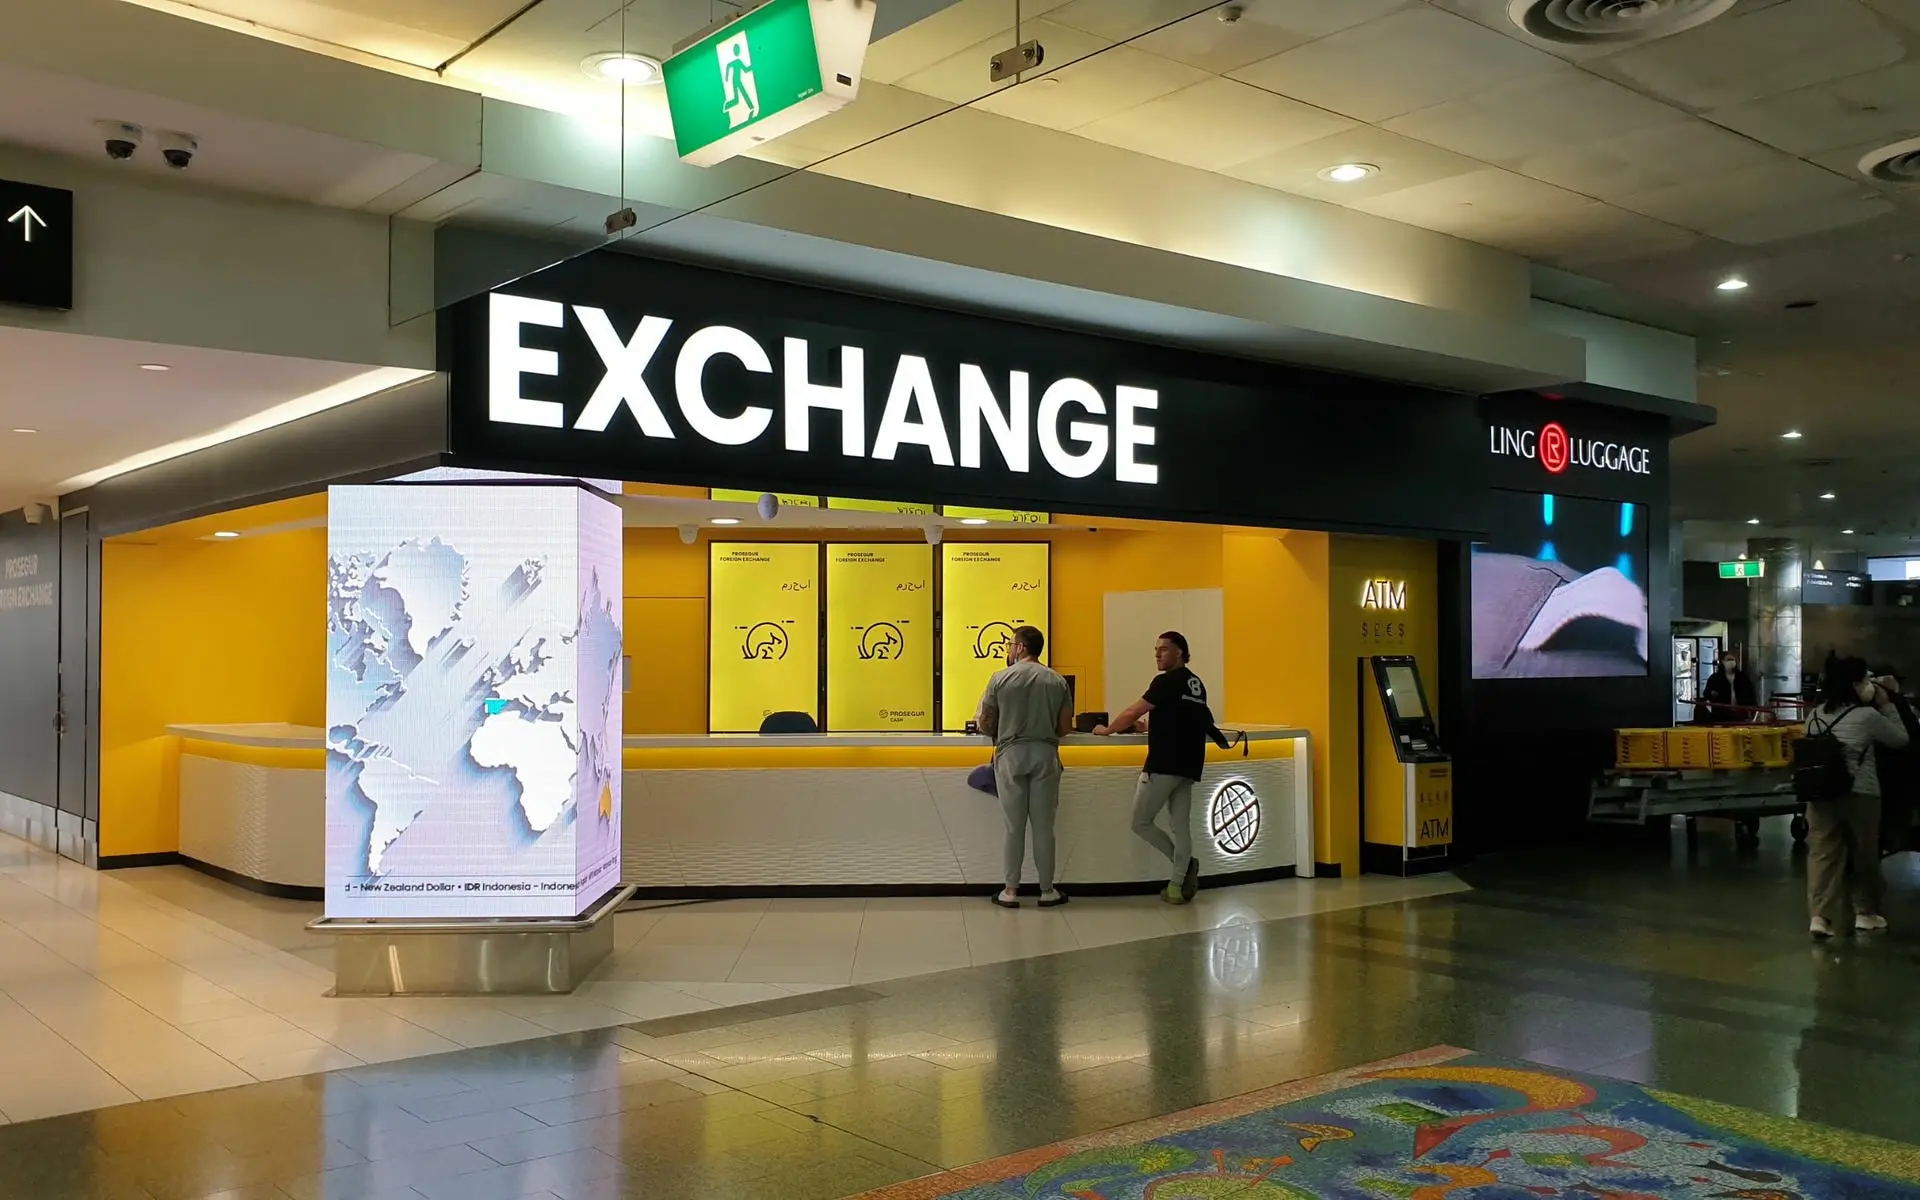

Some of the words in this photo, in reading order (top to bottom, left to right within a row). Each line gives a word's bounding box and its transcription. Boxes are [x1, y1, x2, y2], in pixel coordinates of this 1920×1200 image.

[488, 292, 1160, 486] EXCHANGE
[1490, 425, 1536, 459] LING
[1570, 437, 1651, 474] LUGGAGE
[1362, 579, 1407, 610] ATM
[1421, 816, 1449, 840] ATM
[360, 883, 382, 892] New
[384, 883, 424, 892] Zealand
[426, 883, 455, 892] Dollar
[464, 883, 481, 891] IDR
[482, 882, 532, 891] Indonesia
